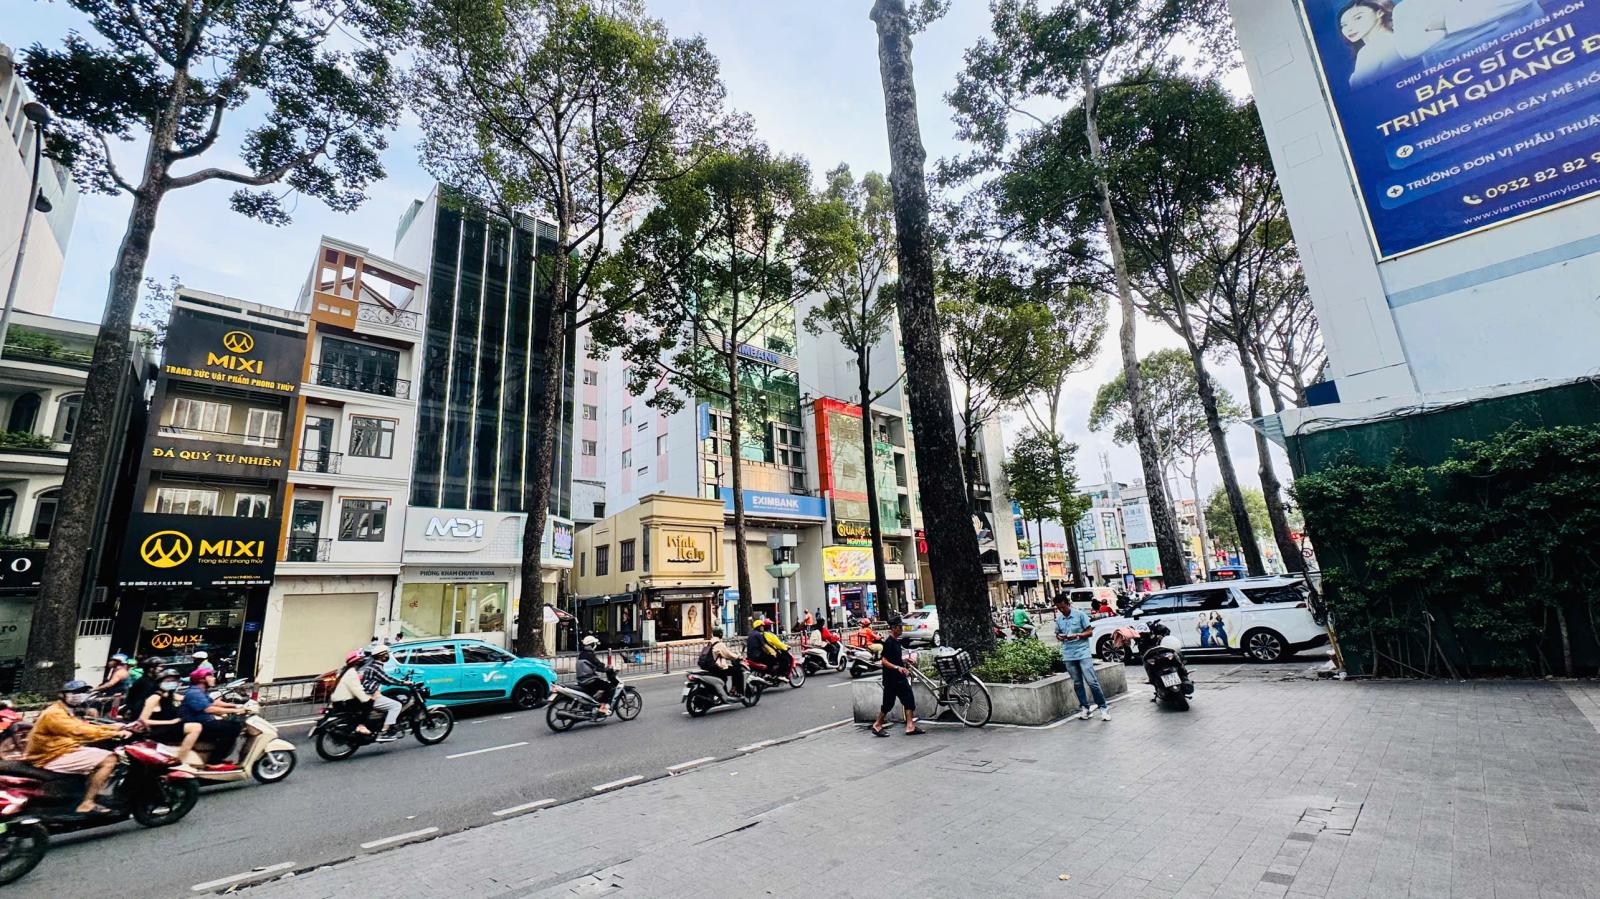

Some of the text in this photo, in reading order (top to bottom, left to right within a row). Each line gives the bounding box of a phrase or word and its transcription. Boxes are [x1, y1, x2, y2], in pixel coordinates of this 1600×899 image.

[1396, 0, 1585, 89] CHỊU TRÁCH NHIỆM CHUYÊN MÔN
[1415, 23, 1576, 102] BÁC SĨ CKII
[1376, 94, 1460, 137] TRỊNH
[1464, 46, 1576, 101] QUANG
[1474, 109, 1515, 128] KHOA
[1517, 93, 1548, 111] GÂY
[1551, 82, 1576, 98] MÊ
[1464, 152, 1496, 171] ĐƠN
[1497, 145, 1513, 159] VỊ
[1485, 177, 1531, 199] 0932
[1534, 168, 1559, 183] 82
[1562, 158, 1587, 173] 82
[207, 352, 263, 375] MIXI
[166, 365, 192, 376] TRANG
[193, 369, 210, 379] SỨC
[251, 379, 275, 389] PHONG
[152, 447, 282, 467] ĐÁ QUÝ TỰ NHIÊN
[752, 496, 799, 508] EXIMBANK
[425, 517, 483, 538] MDI
[198, 539, 265, 557] MIXI
[173, 634, 204, 643] MIXI
